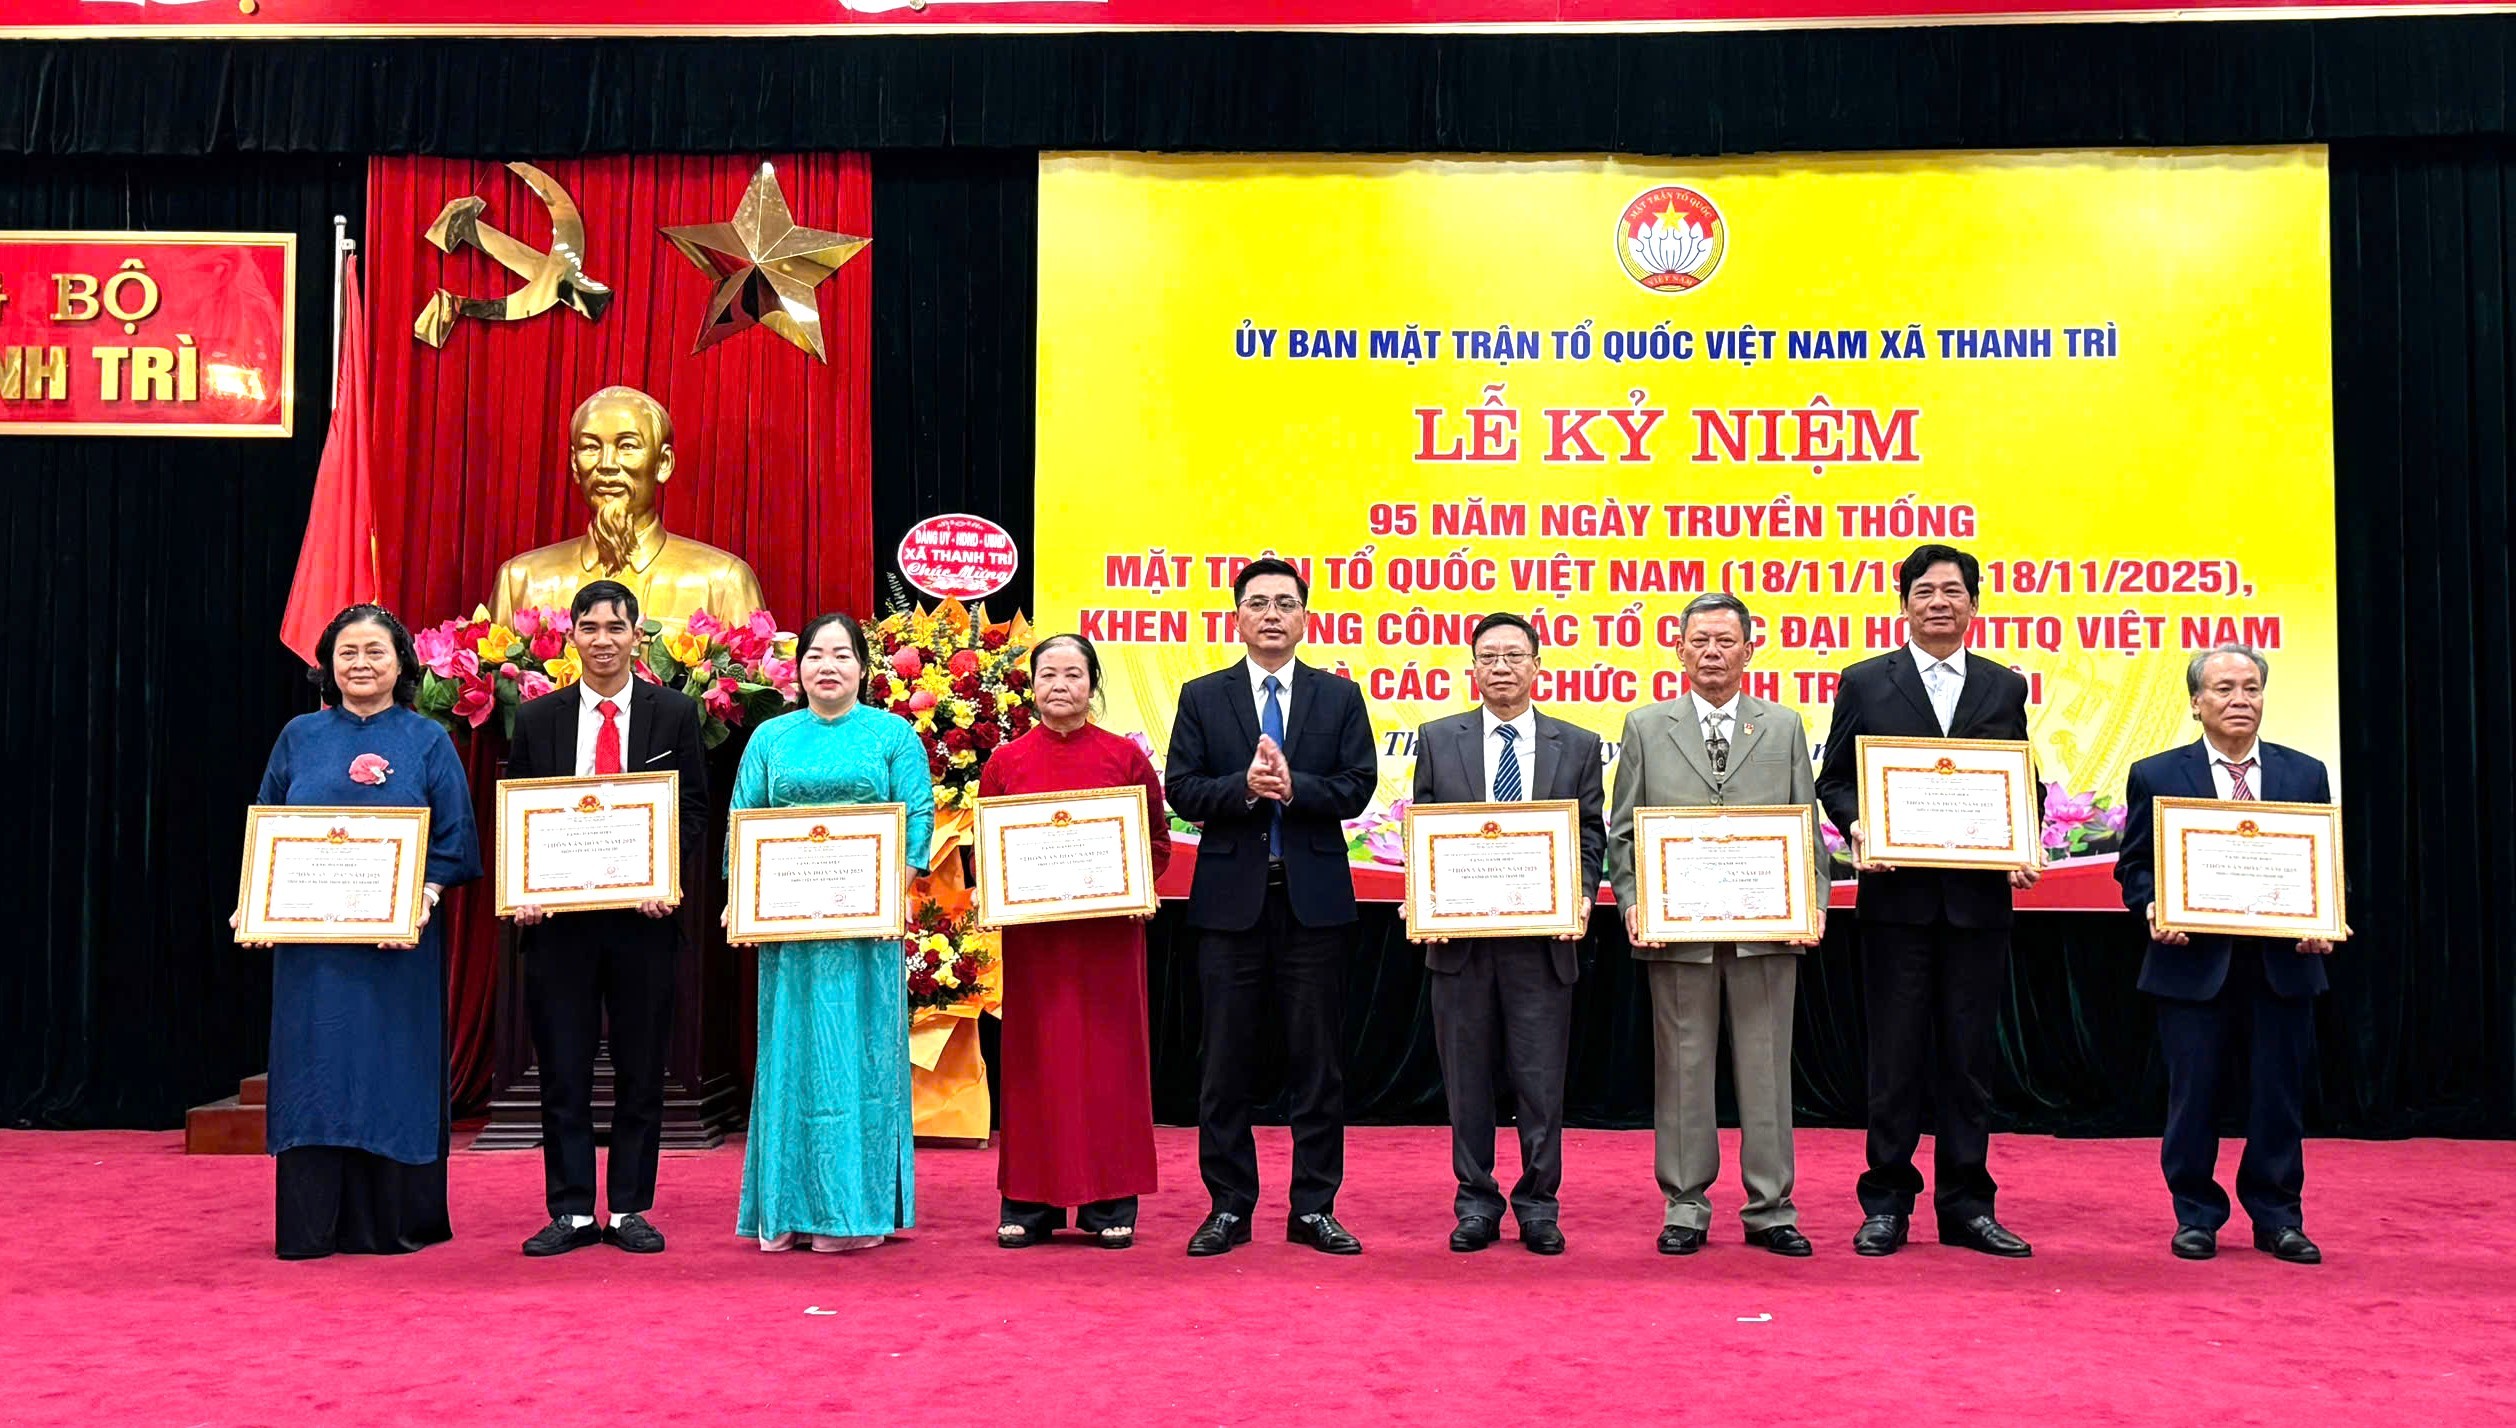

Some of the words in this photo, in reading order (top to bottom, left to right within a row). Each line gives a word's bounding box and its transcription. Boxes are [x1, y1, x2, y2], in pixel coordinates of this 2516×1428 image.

[50, 258, 159, 335] BỘ
[92, 334, 198, 401] TRÌ
[1236, 319, 1276, 358] ỦY
[1289, 330, 1357, 358] BAN
[1370, 324, 1441, 366] MẶT
[1452, 325, 1539, 366] TRẬN
[1552, 319, 1593, 360] TỔ
[1604, 320, 1693, 363] QUỐC
[1706, 324, 1776, 366] VIỆT
[1788, 330, 1867, 359] NAM
[1880, 324, 1925, 359] XÃ
[1938, 329, 2051, 358] THANH
[2064, 321, 2117, 357] TRÌ
[1415, 384, 1517, 461] LỄ
[1544, 390, 1664, 461] KỶ
[1692, 395, 1920, 475] NIỆM
[1370, 503, 1417, 536] 95
[1432, 498, 1526, 536] NĂM
[1541, 498, 1650, 537] NGÀY
[1664, 494, 1822, 537] TRUYỀN
[1837, 494, 1974, 537] THỐNG
[904, 546, 928, 561] XÃ
[931, 549, 985, 564] THANH
[1106, 548, 1193, 594] MẶT
[1205, 550, 1311, 589] TRN
[1324, 545, 1375, 590] TỔ
[1388, 547, 1495, 594] QUỐC
[1510, 553, 1596, 599] VIỆT
[1610, 560, 1704, 592] NAM
[1080, 610, 1187, 643] KHEN
[1516, 607, 1579, 647] ÁC
[1593, 602, 1644, 647] TỔ
[1780, 616, 1849, 656] ĐẠI
[2077, 609, 2166, 656] VIỆT
[2181, 616, 2281, 649] NAM
[1370, 661, 1451, 701] CÁC
[1793, 672, 1842, 704] TR
